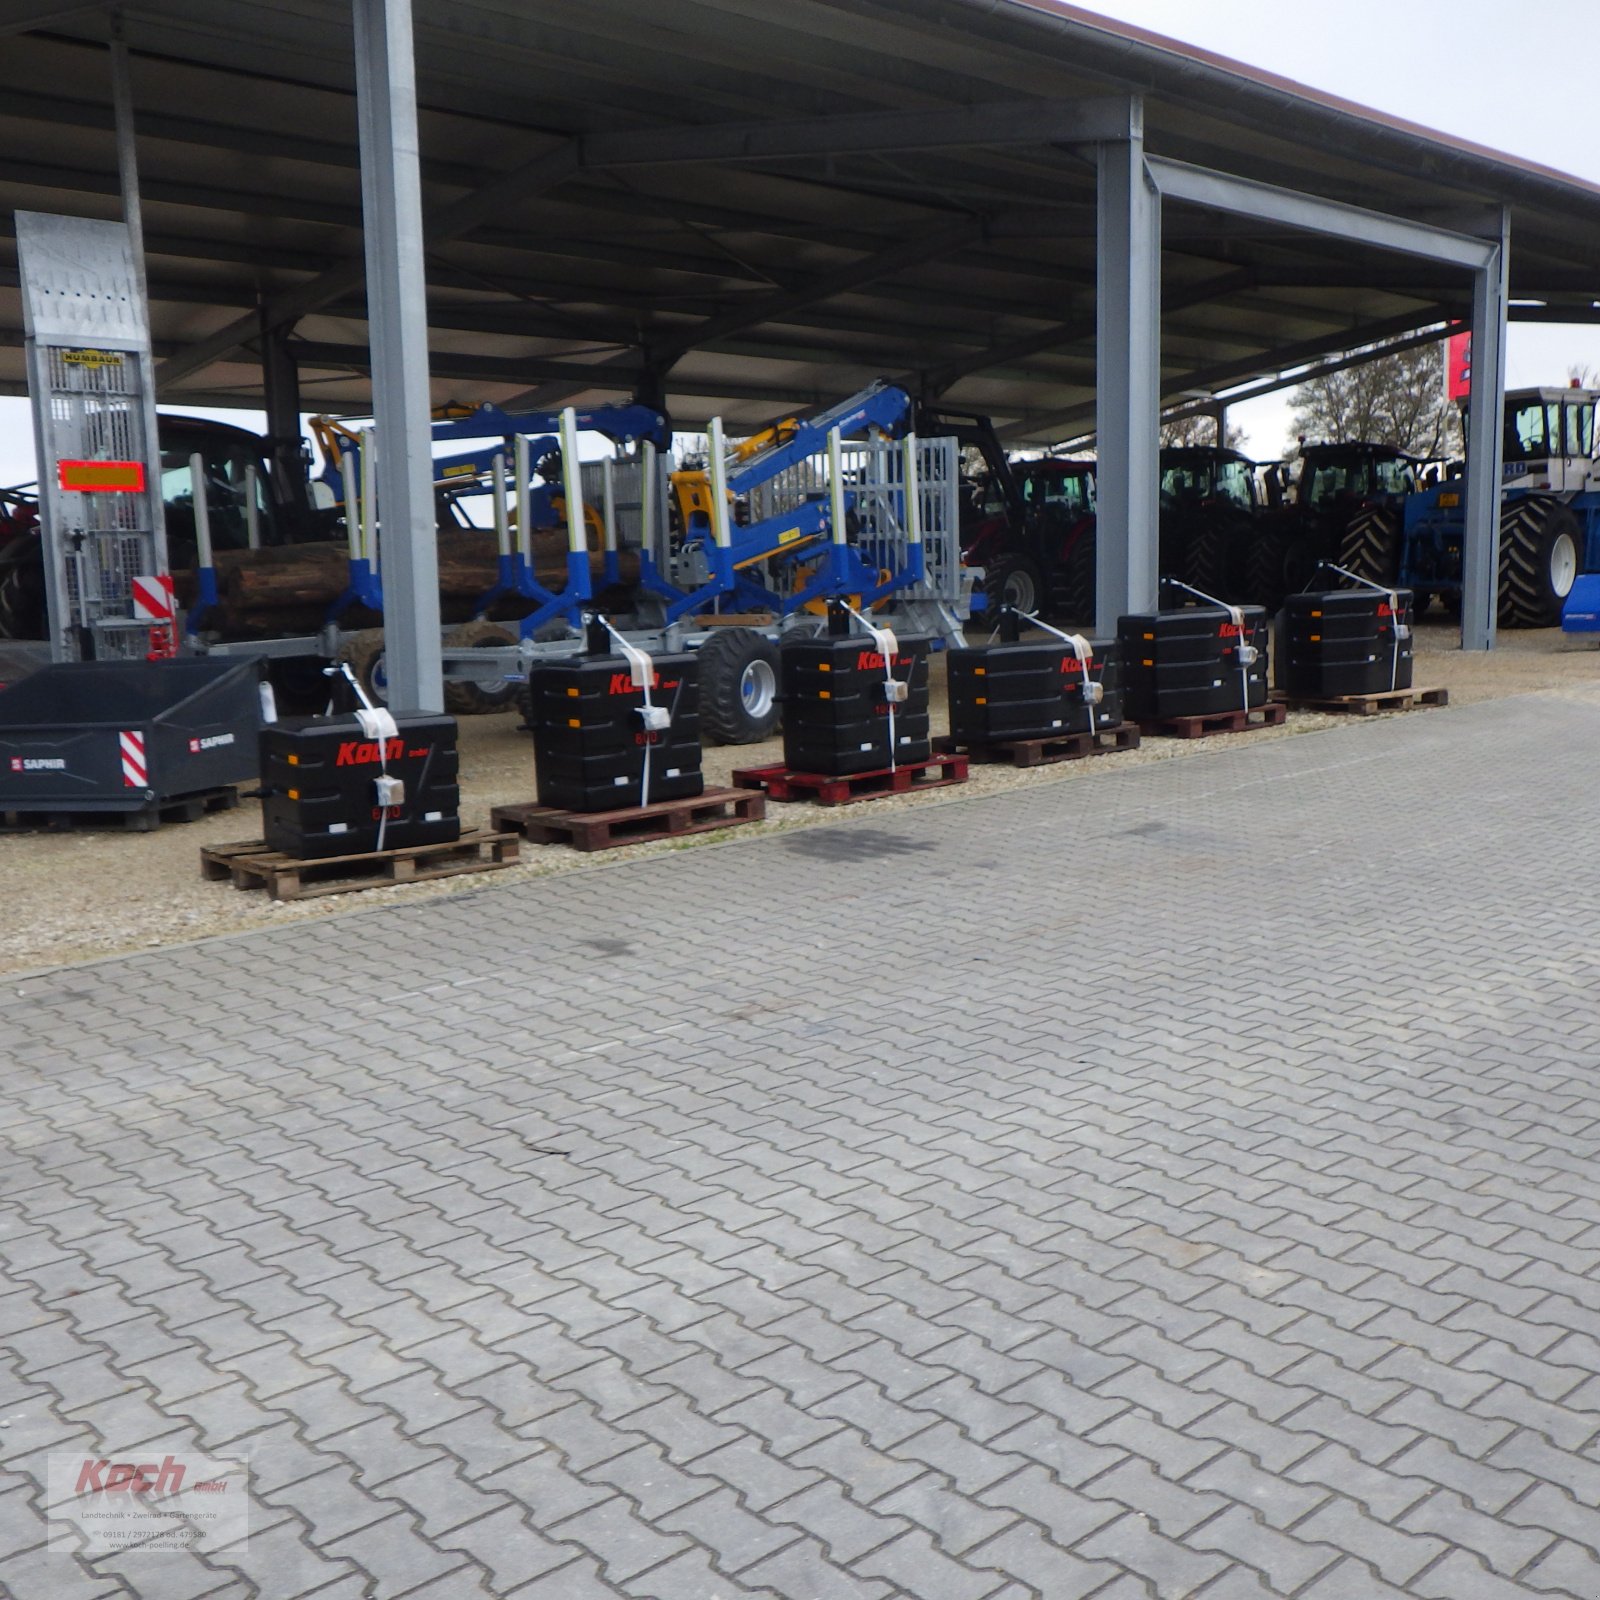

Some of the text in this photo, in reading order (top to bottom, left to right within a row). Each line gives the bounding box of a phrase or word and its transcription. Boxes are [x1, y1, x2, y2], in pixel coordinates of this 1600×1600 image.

[65, 353, 120, 363] HUMBAUR
[200, 733, 234, 749] SAPHIR
[24, 758, 65, 769] SAPHIR
